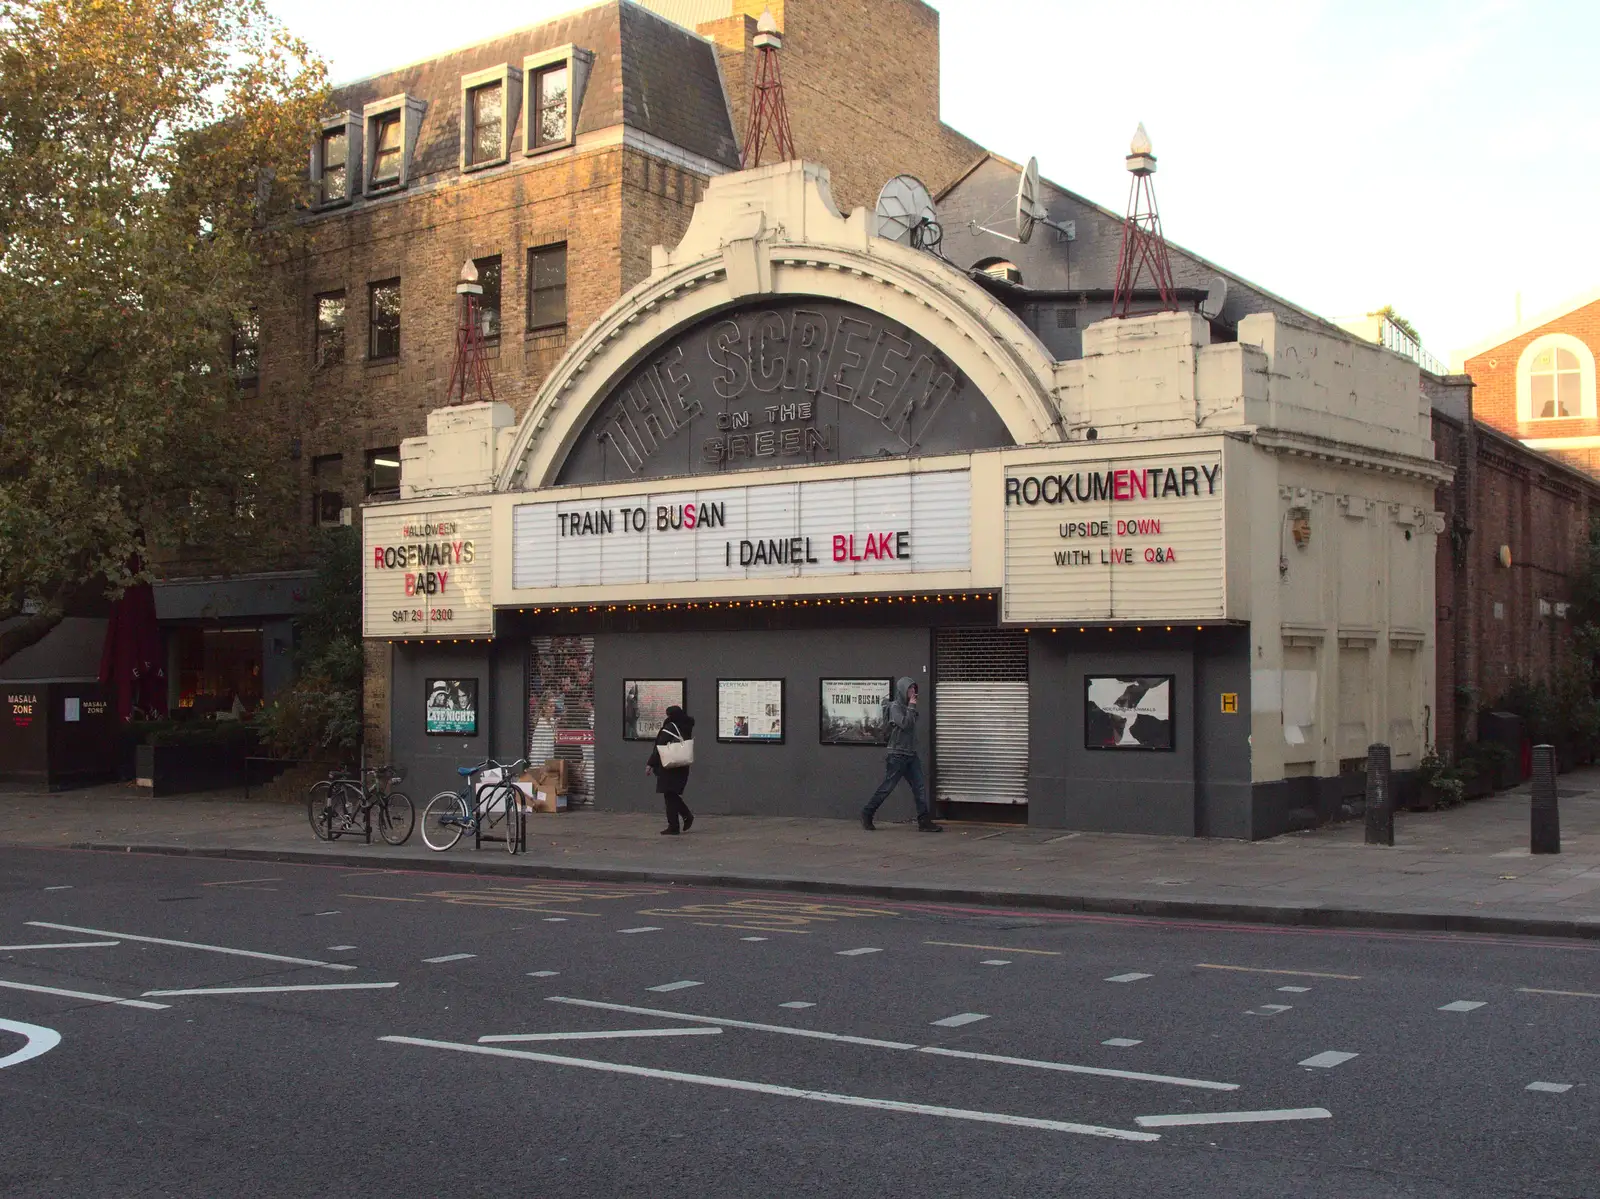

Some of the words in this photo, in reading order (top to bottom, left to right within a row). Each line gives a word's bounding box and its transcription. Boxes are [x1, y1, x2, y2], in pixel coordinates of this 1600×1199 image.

[596, 345, 703, 474] THE
[705, 309, 957, 449] SCREEN
[715, 411, 750, 428] ON
[764, 402, 813, 424] THE
[702, 422, 834, 464] GREEN
[1005, 463, 1219, 506] ROCKUMENTARY
[403, 522, 457, 538] HALLOWEEN
[558, 509, 613, 537] TRAIN
[620, 507, 647, 533] TO
[656, 501, 725, 532] BUSAN
[1059, 520, 1109, 538] UPSIDE
[1116, 518, 1161, 536] DOWN
[374, 540, 474, 569] ROSEMARYS
[725, 541, 730, 567] I
[740, 537, 818, 567] DANIEL
[832, 531, 911, 563] BLAKE
[1054, 549, 1091, 566] WITH
[1100, 548, 1133, 565] LIVE
[1144, 546, 1176, 564] Q&A
[404, 570, 448, 598] BABY
[392, 610, 409, 622] SAT
[411, 609, 424, 621] 29
[430, 607, 453, 621] 2300
[8, 695, 37, 704] MASALA
[13, 705, 33, 714] ZONE
[831, 694, 851, 705] TRAIN
[857, 694, 880, 705] BUSAN
